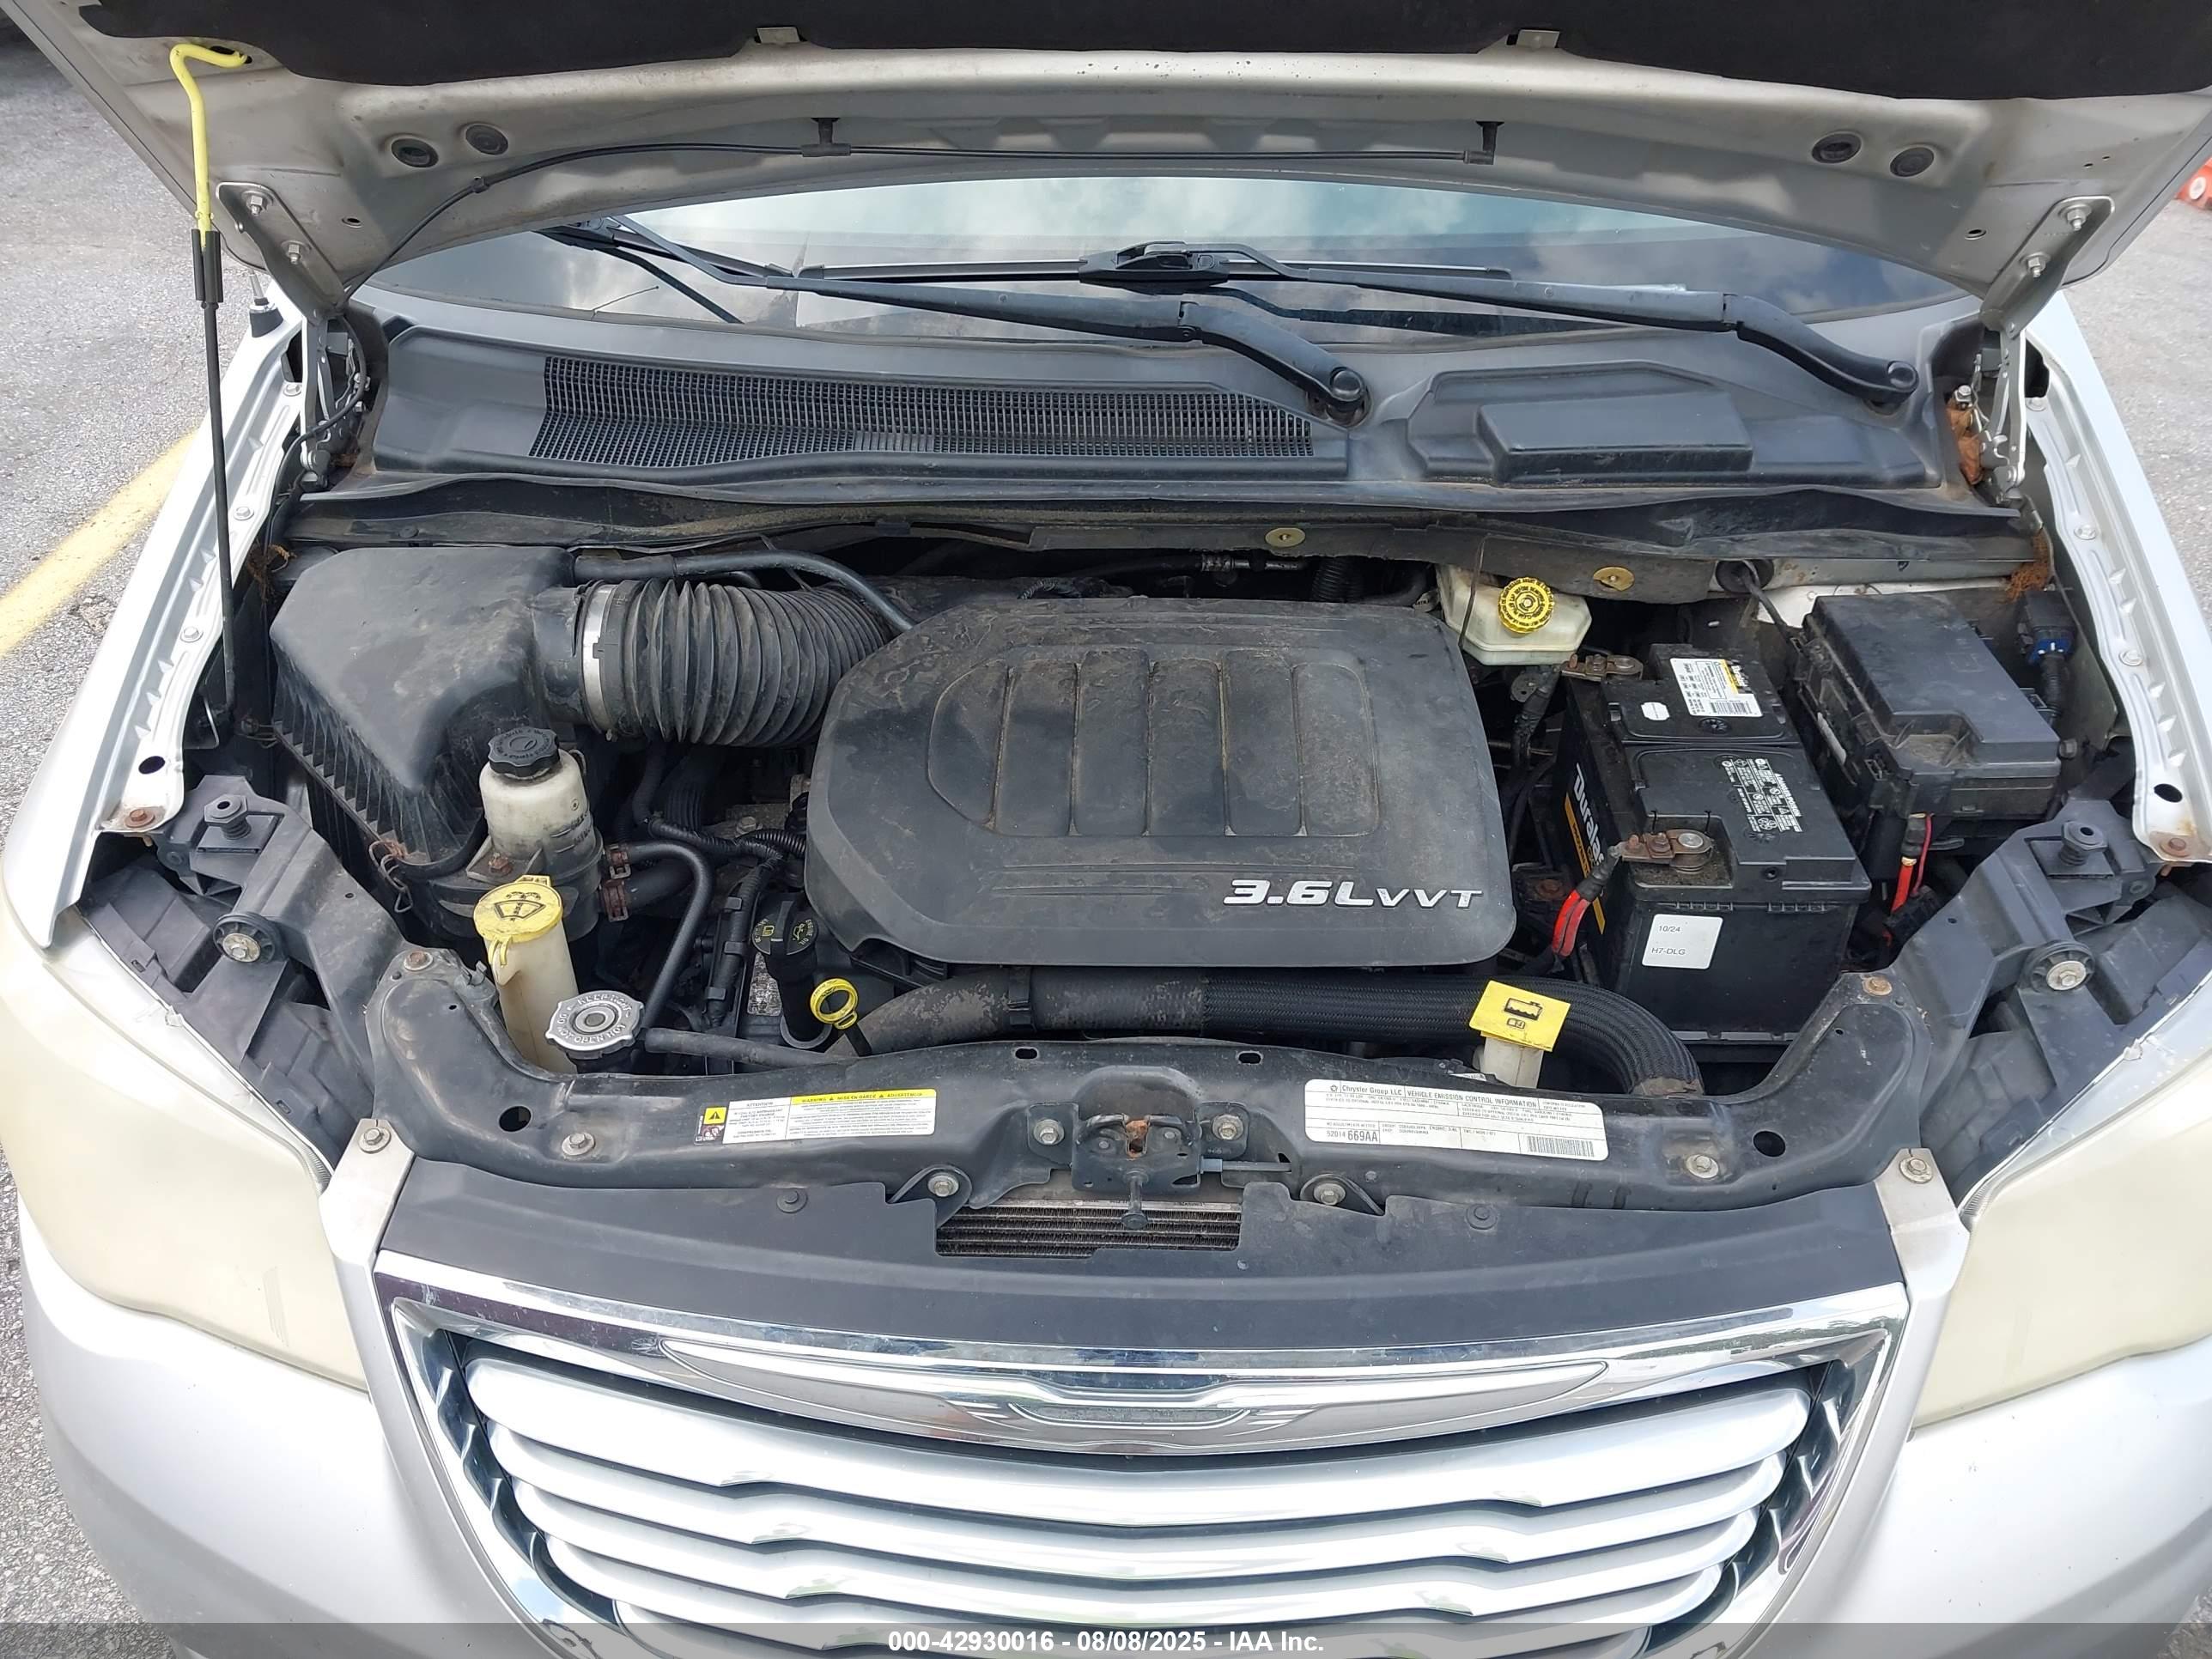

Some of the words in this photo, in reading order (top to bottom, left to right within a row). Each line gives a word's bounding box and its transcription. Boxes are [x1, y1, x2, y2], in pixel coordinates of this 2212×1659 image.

[1574, 763, 1605, 866] Duralas
[1223, 879, 1374, 907] 3.6L
[1375, 888, 1483, 908] VVT
[1651, 947, 1686, 956] H7-DLG
[577, 994, 608, 1006] KEEP
[574, 1035, 605, 1044] OPEN
[1341, 1085, 1368, 1094] Chrysler
[1370, 1086, 1389, 1096] Group
[1407, 1090, 1432, 1099] VEHICLE
[1434, 1092, 1463, 1101] EMISSION
[1465, 1096, 1492, 1104] CONTROL
[1494, 1098, 1537, 1109] INFORMATION
[1347, 1130, 1378, 1142] 669AA
